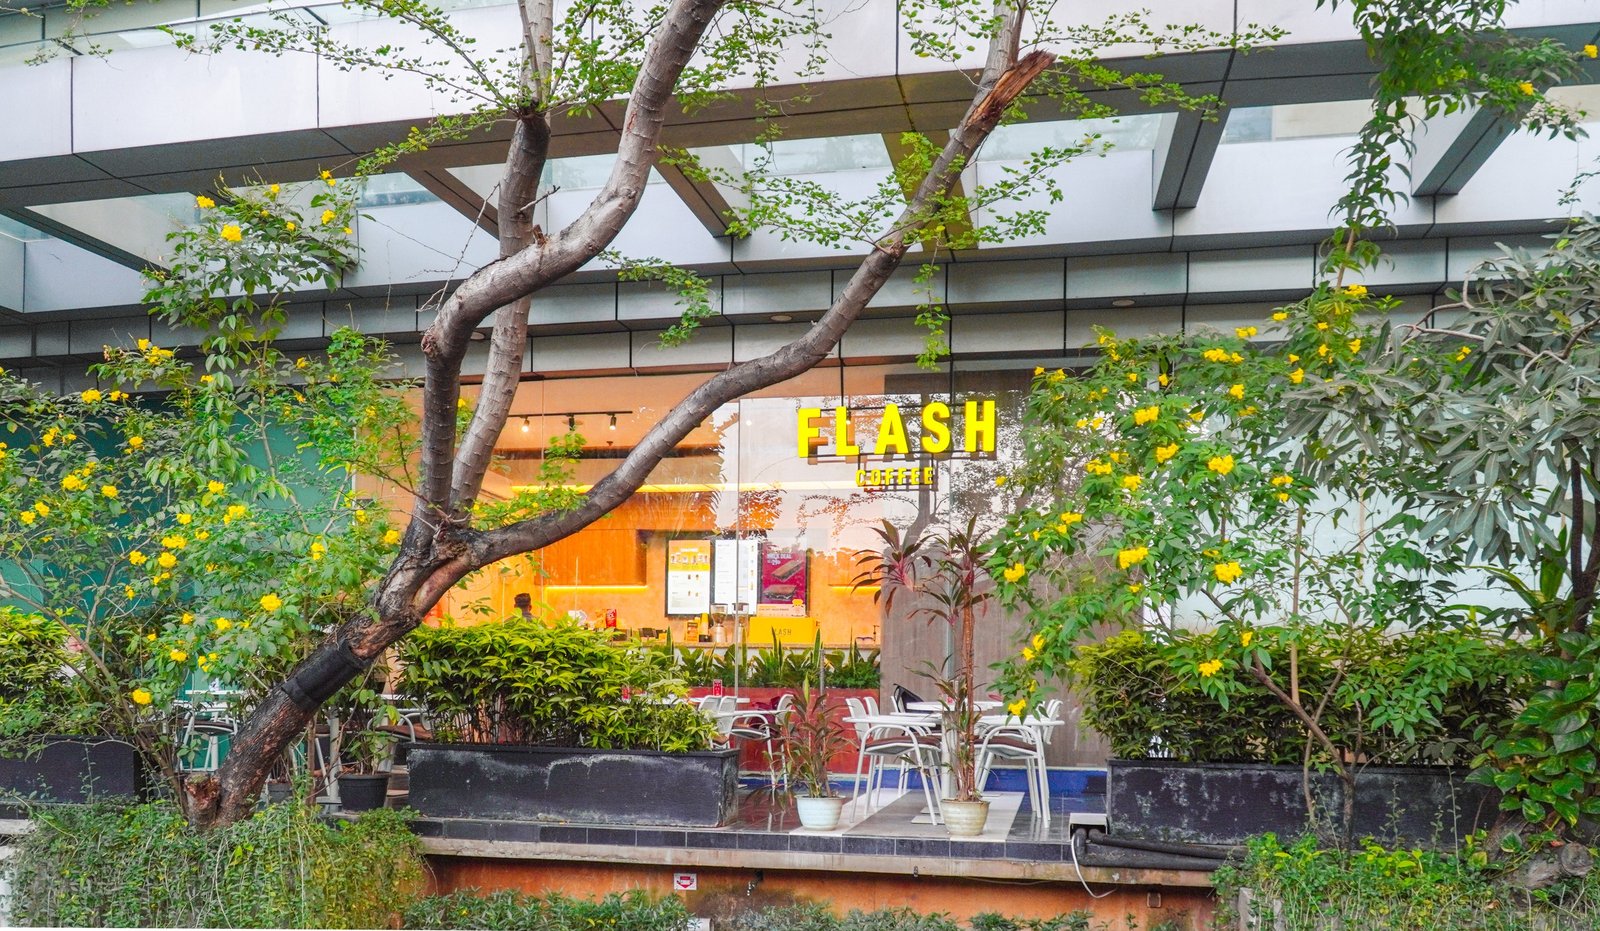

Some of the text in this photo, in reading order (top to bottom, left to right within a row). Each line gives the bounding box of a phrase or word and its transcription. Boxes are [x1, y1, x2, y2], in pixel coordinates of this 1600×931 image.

[797, 400, 996, 458] FLASH
[855, 467, 934, 487] COFFEE
[772, 628, 792, 636] LASH
